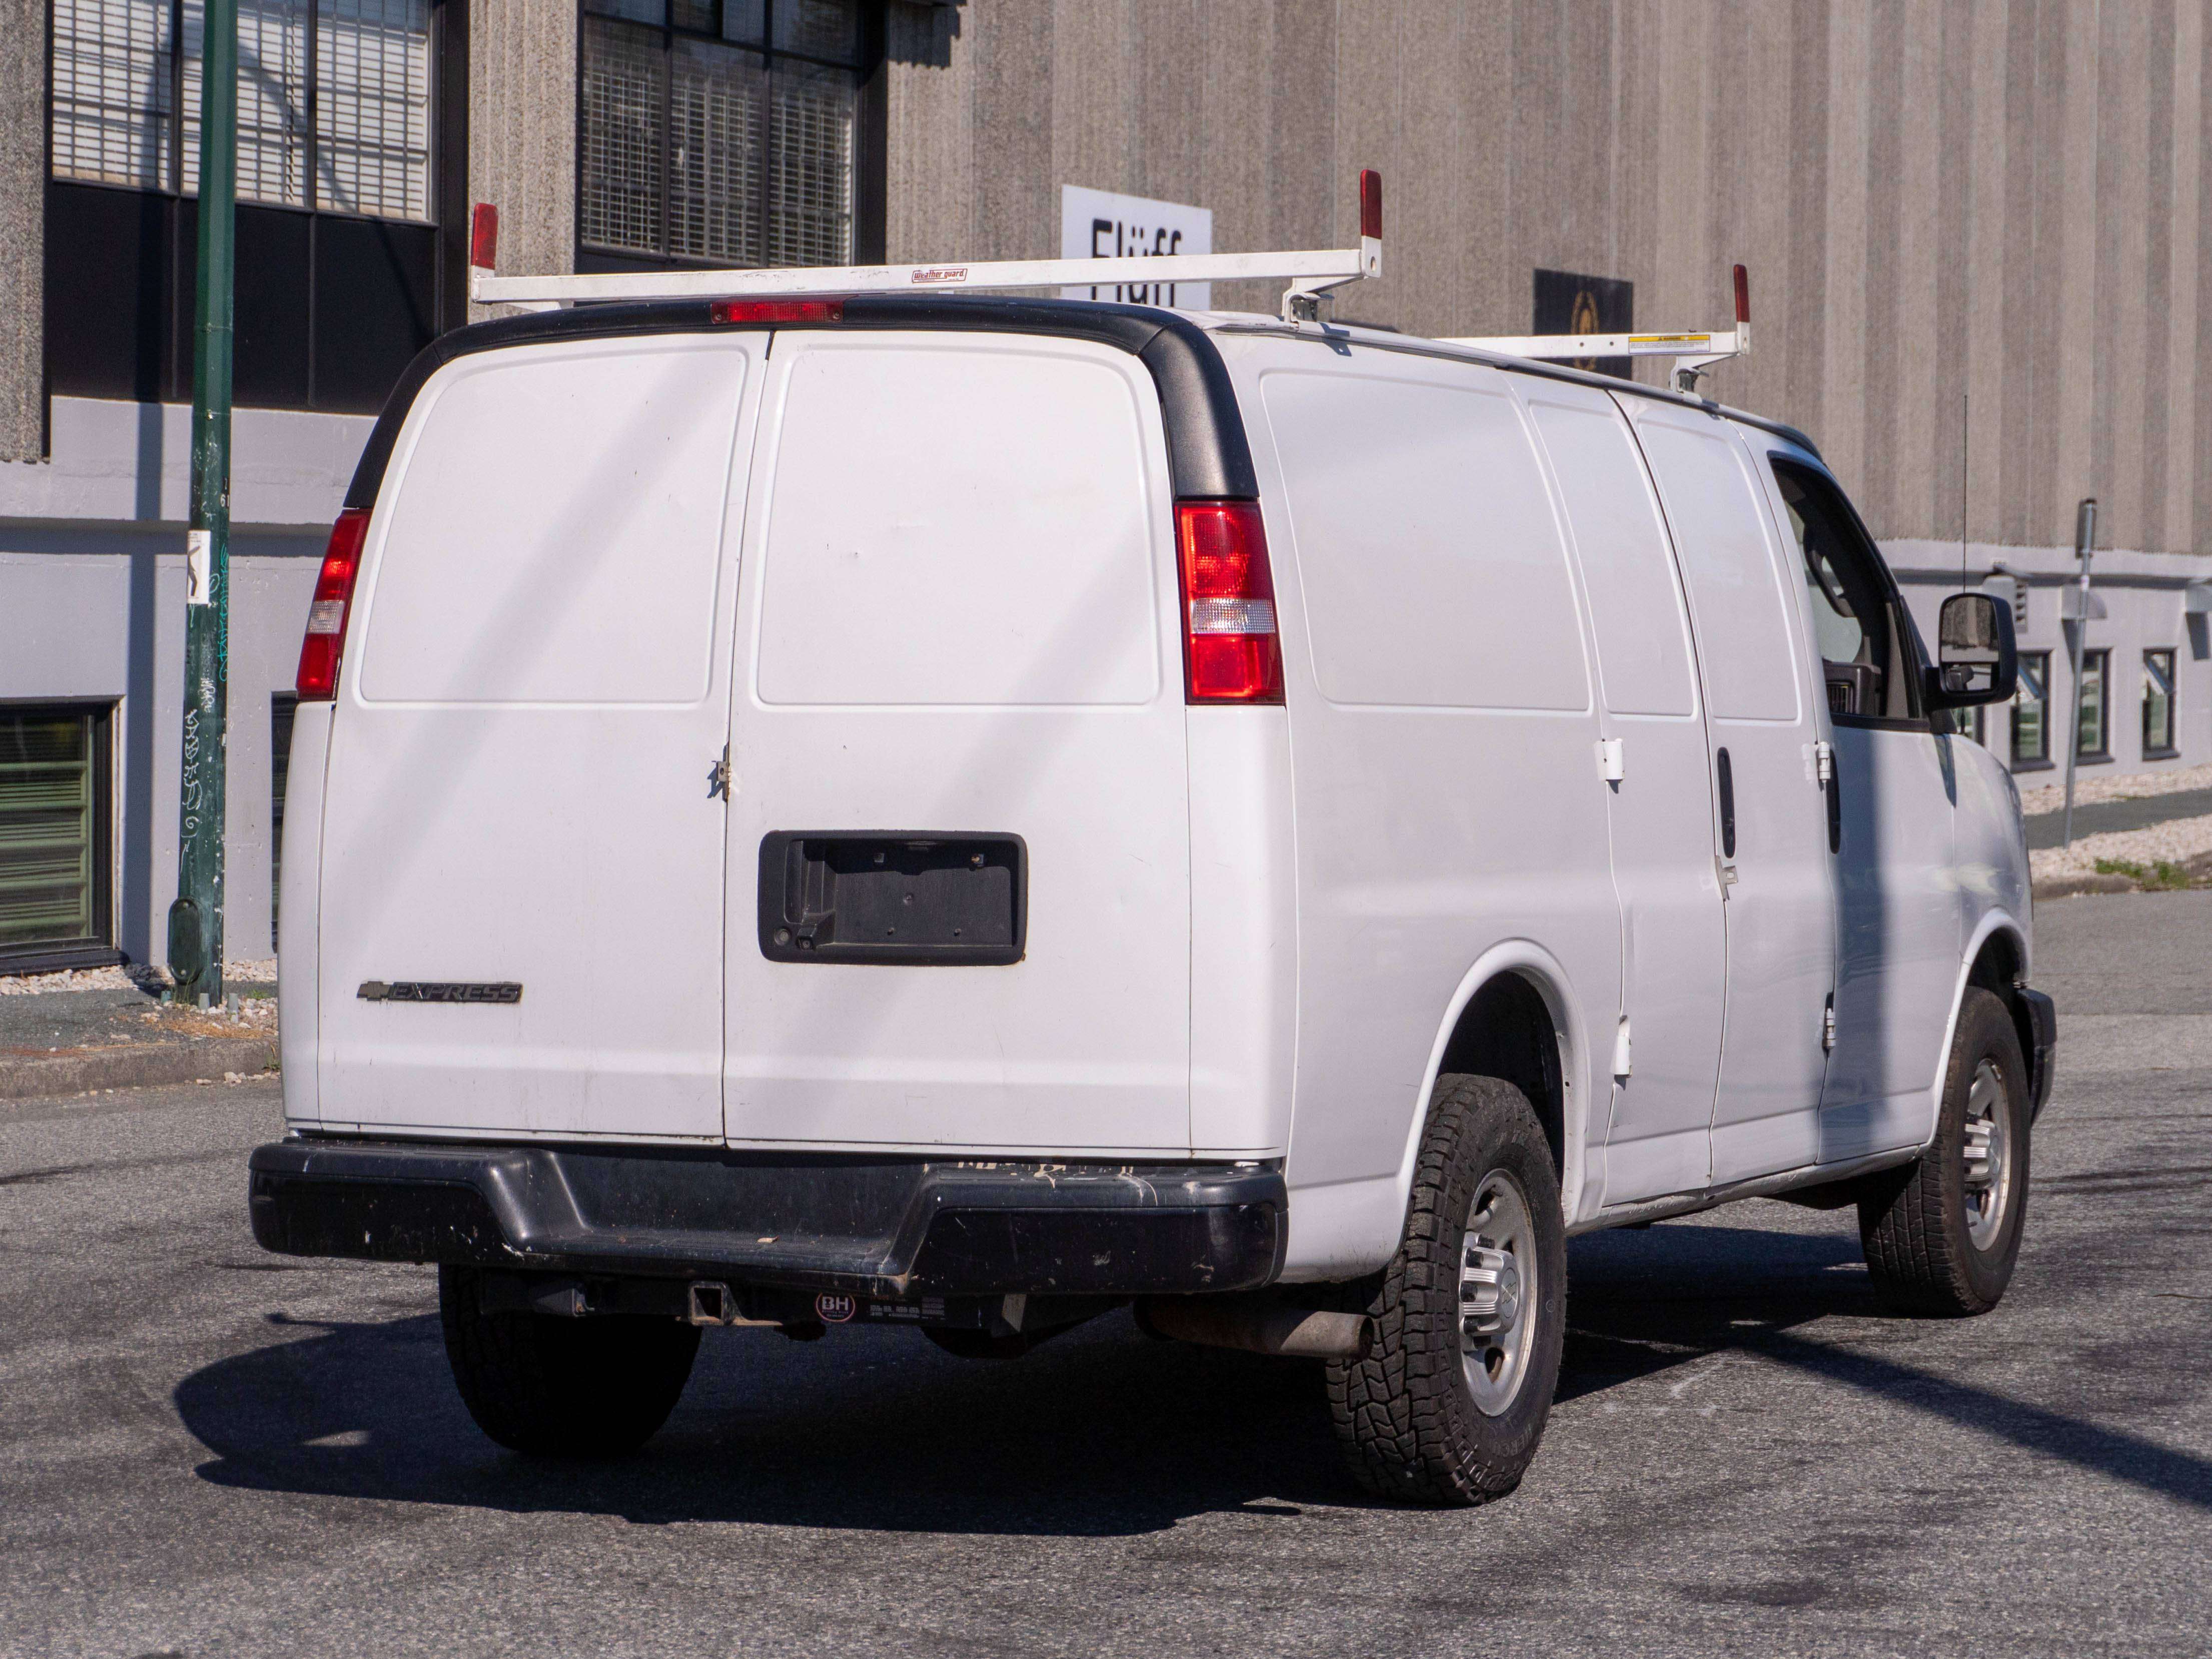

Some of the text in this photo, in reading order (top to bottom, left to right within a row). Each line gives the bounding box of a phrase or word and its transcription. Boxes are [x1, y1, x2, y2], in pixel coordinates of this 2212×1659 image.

[1091, 219, 1182, 307] Flüff
[392, 983, 520, 1002] EXPRESS
[822, 1296, 849, 1311] BH
